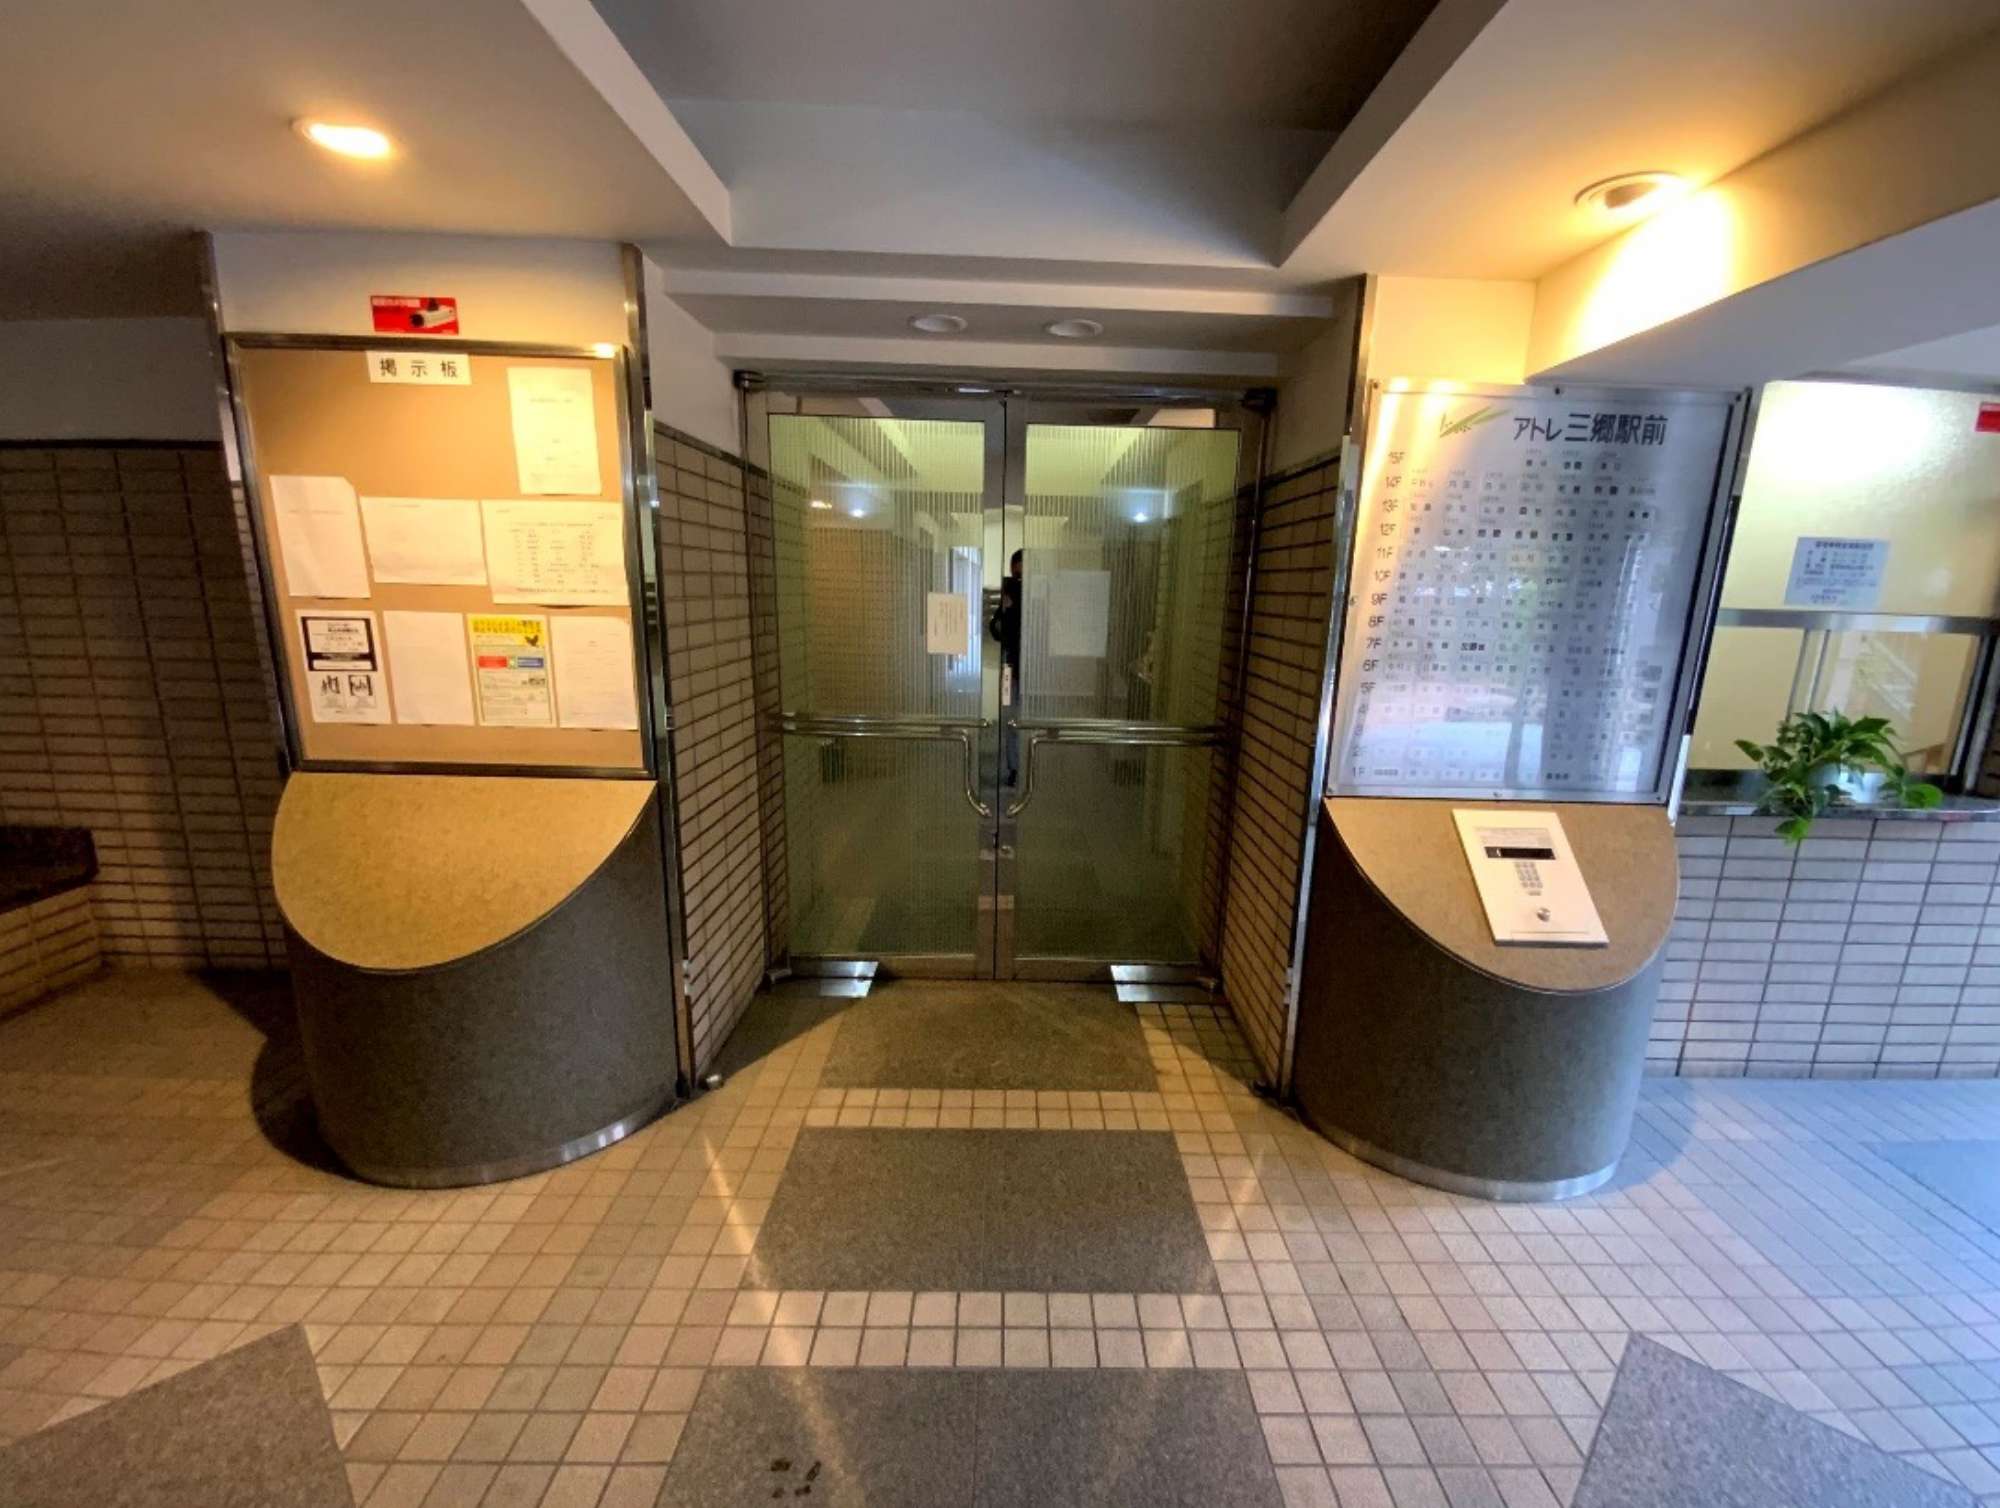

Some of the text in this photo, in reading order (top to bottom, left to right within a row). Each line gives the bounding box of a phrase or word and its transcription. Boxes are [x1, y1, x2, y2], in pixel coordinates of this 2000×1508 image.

[379, 358, 458, 378] 掲示板
[1513, 412, 1669, 446] アトレ三郷駅前
[1385, 476, 1402, 488] 14F
[1380, 523, 1397, 536] 12F
[1377, 546, 1393, 560] 11F
[1365, 637, 1382, 649] 7F
[1362, 659, 1379, 672] 6F
[1360, 681, 1377, 694] 5F
[1352, 767, 1366, 777] 1F
